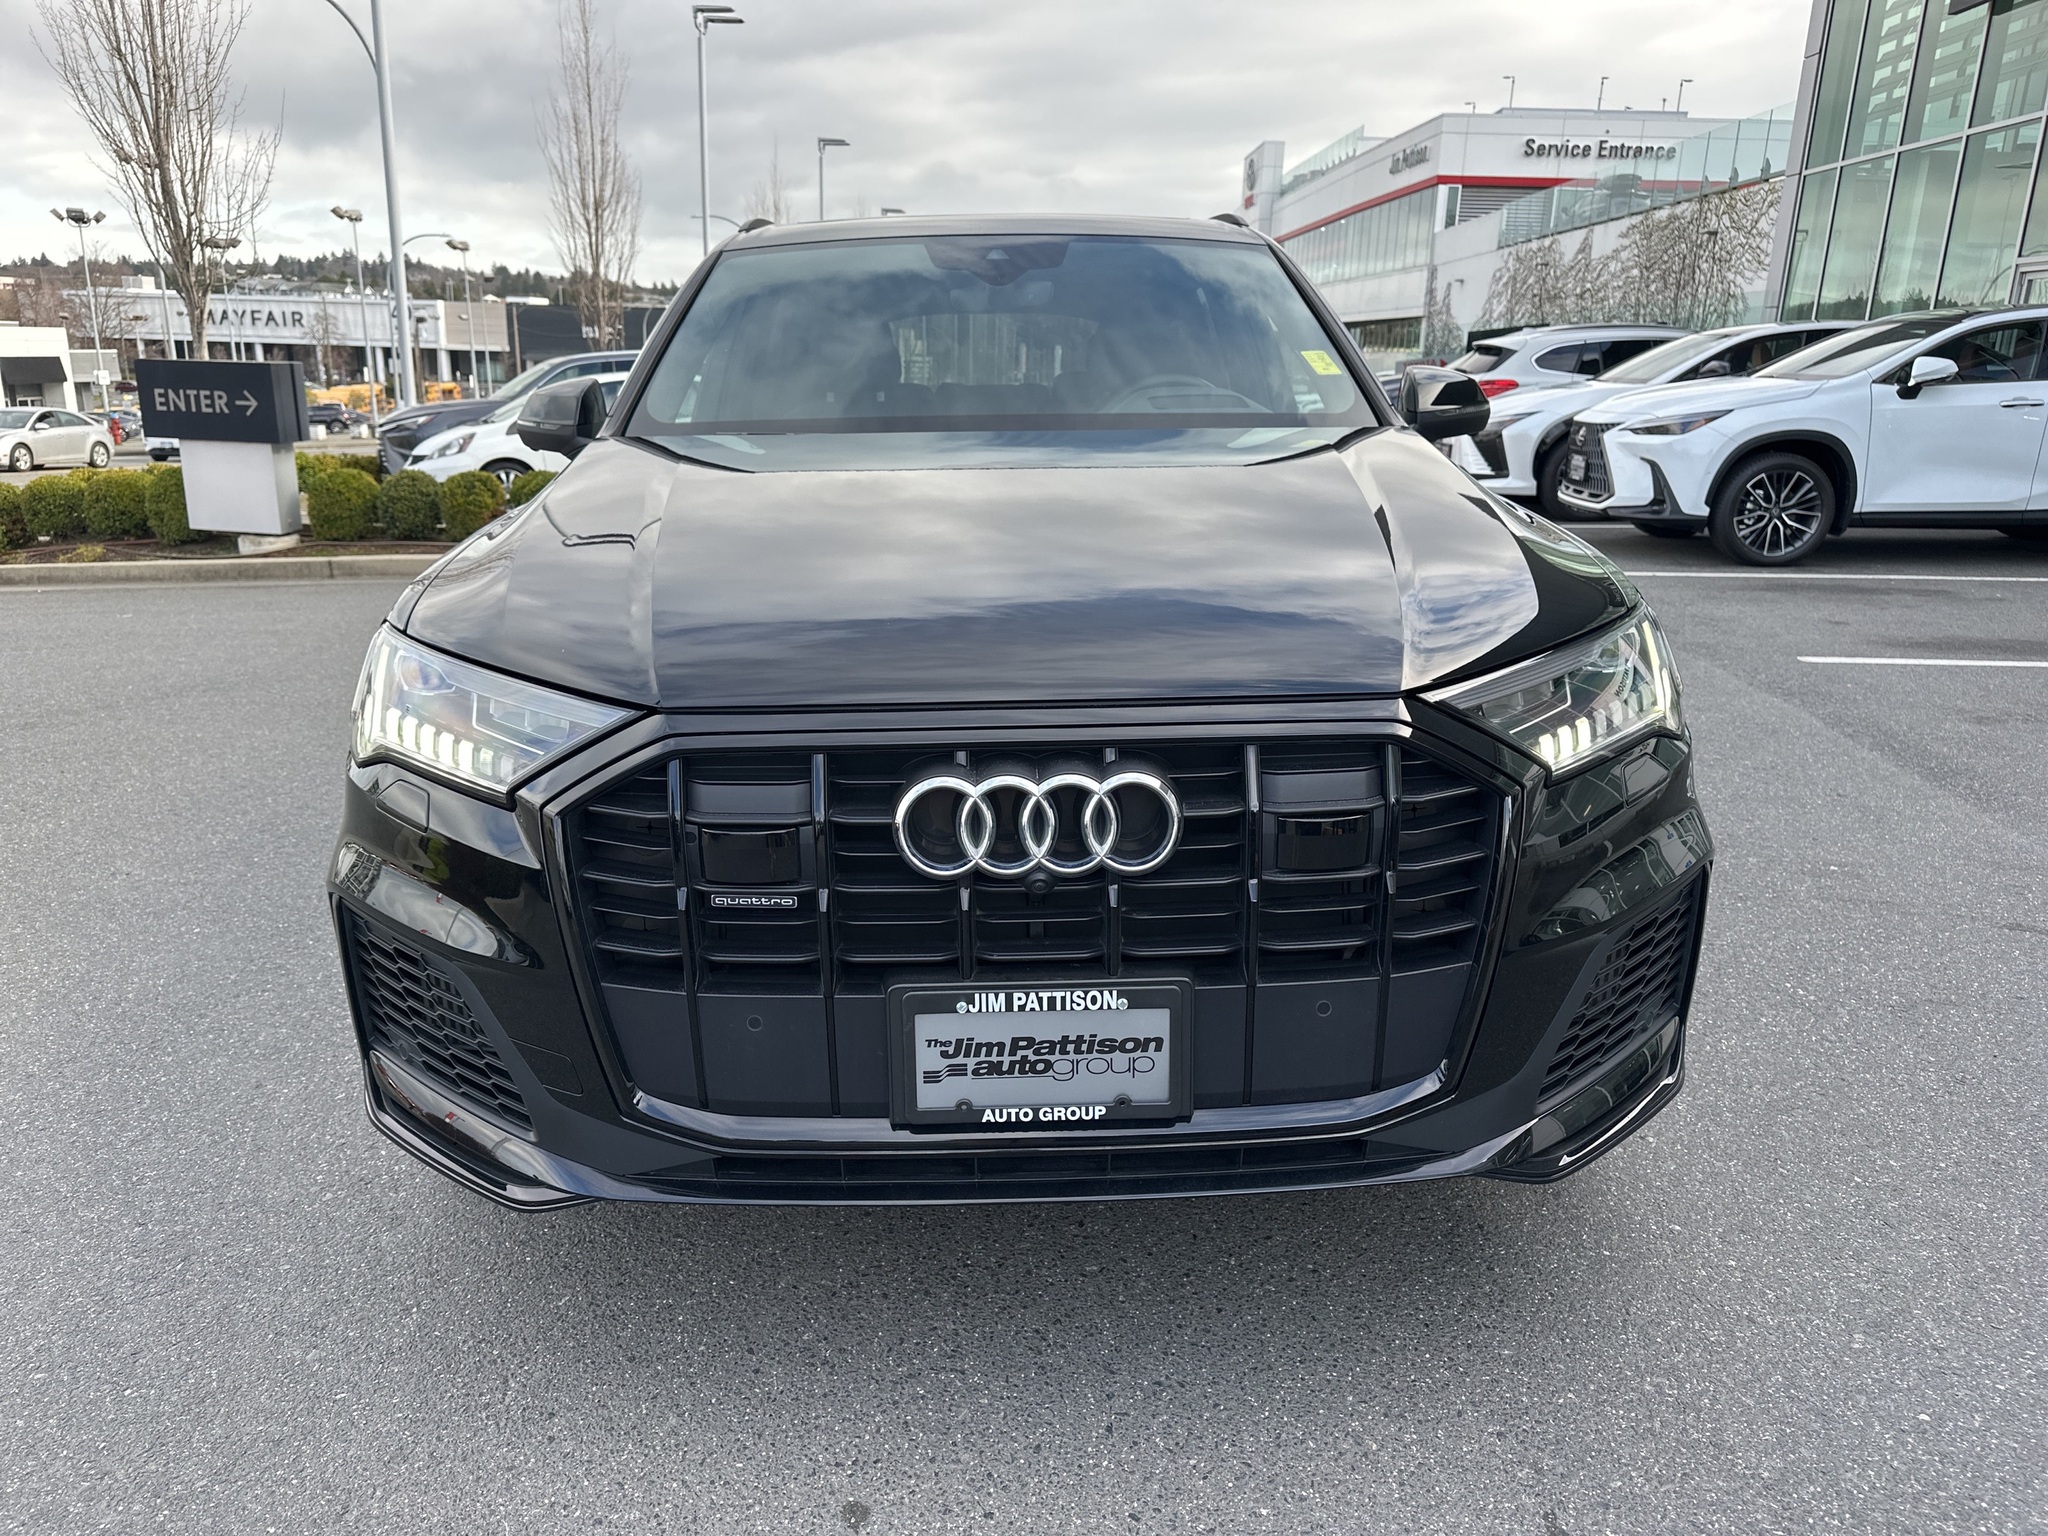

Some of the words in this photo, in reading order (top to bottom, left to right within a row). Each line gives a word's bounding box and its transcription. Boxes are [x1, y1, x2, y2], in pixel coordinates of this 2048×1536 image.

[1524, 138, 1592, 159] Service
[1597, 139, 1677, 161] Entrance
[153, 388, 230, 414] ENTER
[715, 897, 793, 906] quattro
[968, 992, 1006, 1013] JIM
[1013, 990, 1118, 1012] PATTISON
[925, 1038, 953, 1048] The
[940, 1037, 1006, 1060] Jim
[1008, 1034, 1164, 1057] Pattison
[981, 1108, 1034, 1123] AUTO
[1038, 1105, 1107, 1122] GROUP
